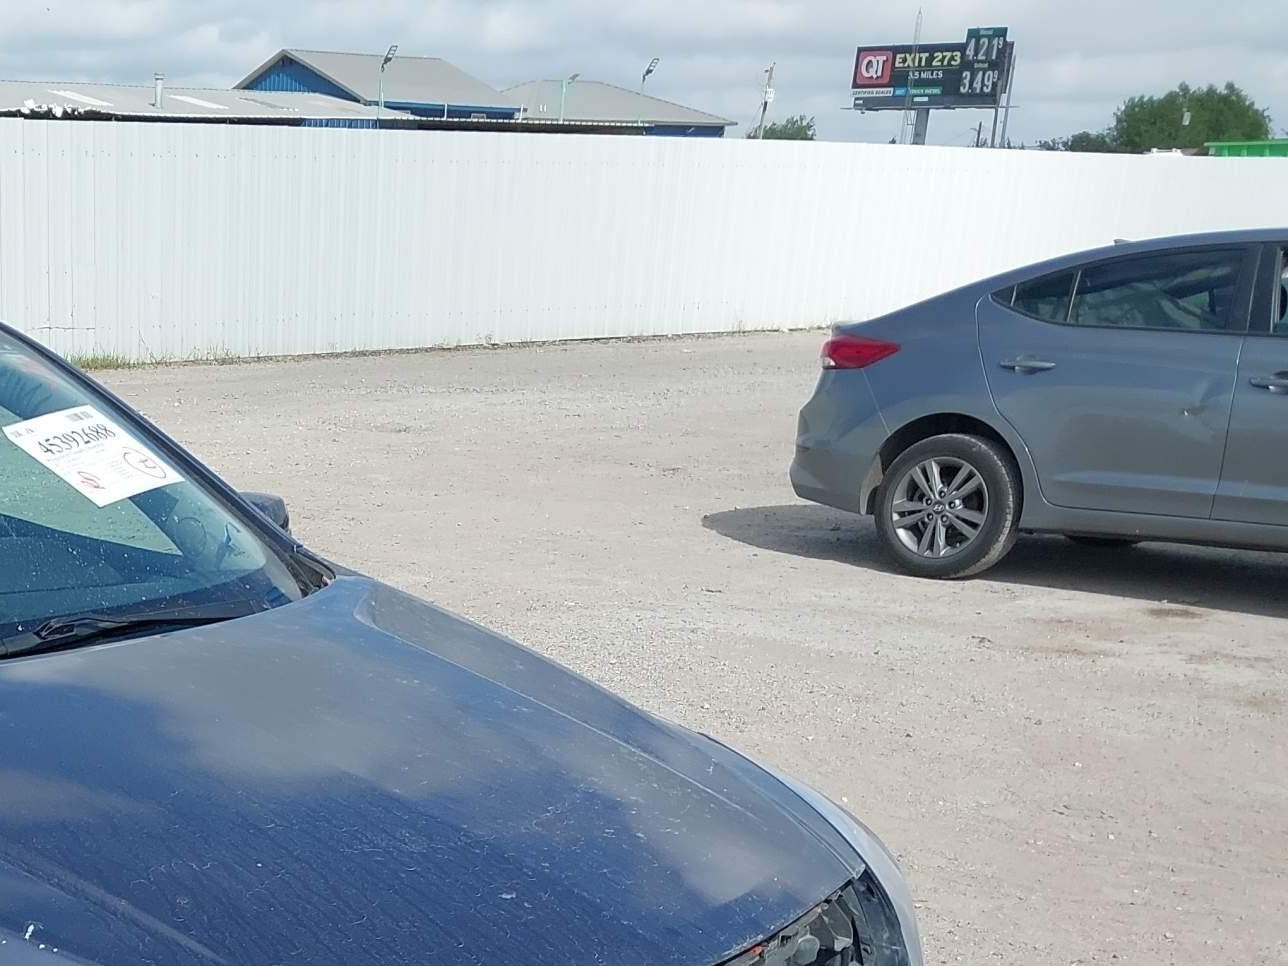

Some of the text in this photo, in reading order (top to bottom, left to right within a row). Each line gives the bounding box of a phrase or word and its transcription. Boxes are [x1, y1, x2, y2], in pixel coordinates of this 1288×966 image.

[862, 55, 886, 79] QT
[895, 51, 961, 68] EXIT 273
[921, 70, 943, 79] MILES
[36, 423, 117, 455] 45392688
